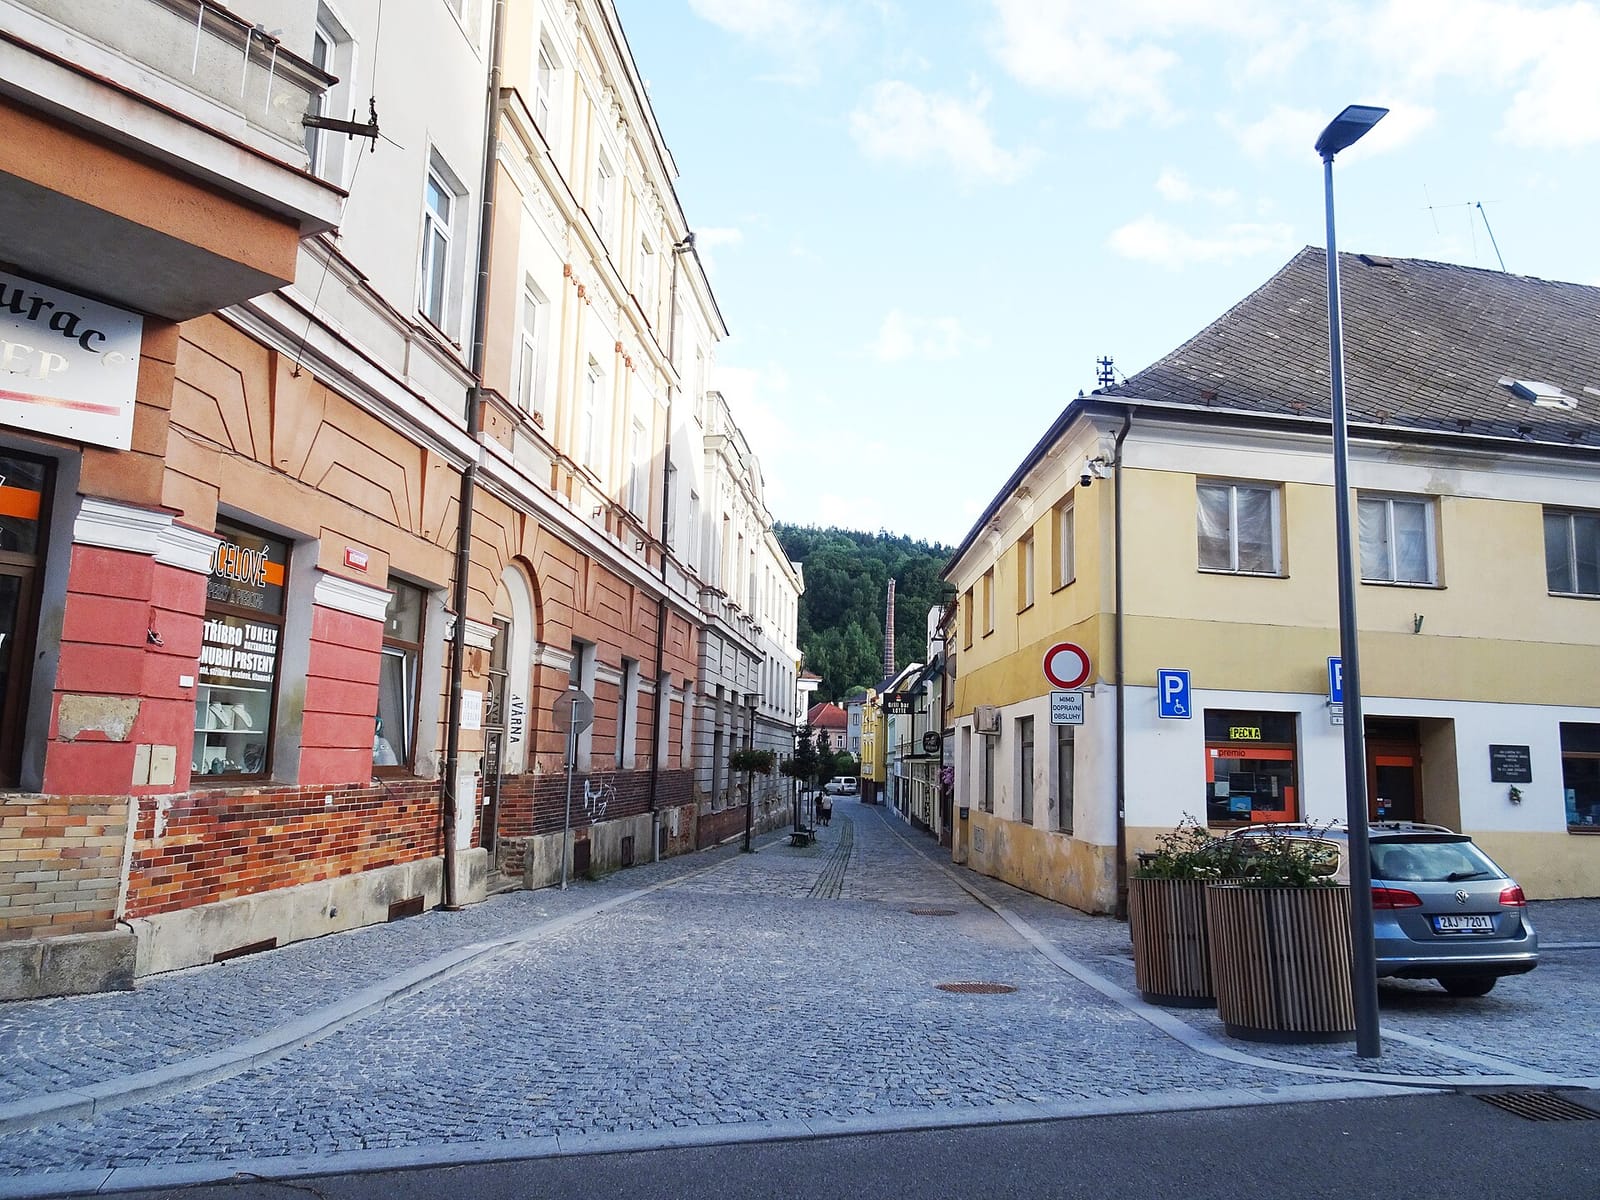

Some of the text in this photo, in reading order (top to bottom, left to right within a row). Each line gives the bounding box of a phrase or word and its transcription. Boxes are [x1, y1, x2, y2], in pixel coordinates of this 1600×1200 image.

[202, 619, 243, 646] TŘÍBRO
[200, 645, 275, 673] NUBNÍ PRSTENY
[1164, 675, 1183, 703] P
[1052, 703, 1082, 711] DOPRAVNÍ
[1440, 915, 1489, 928] 2AJ 7201
